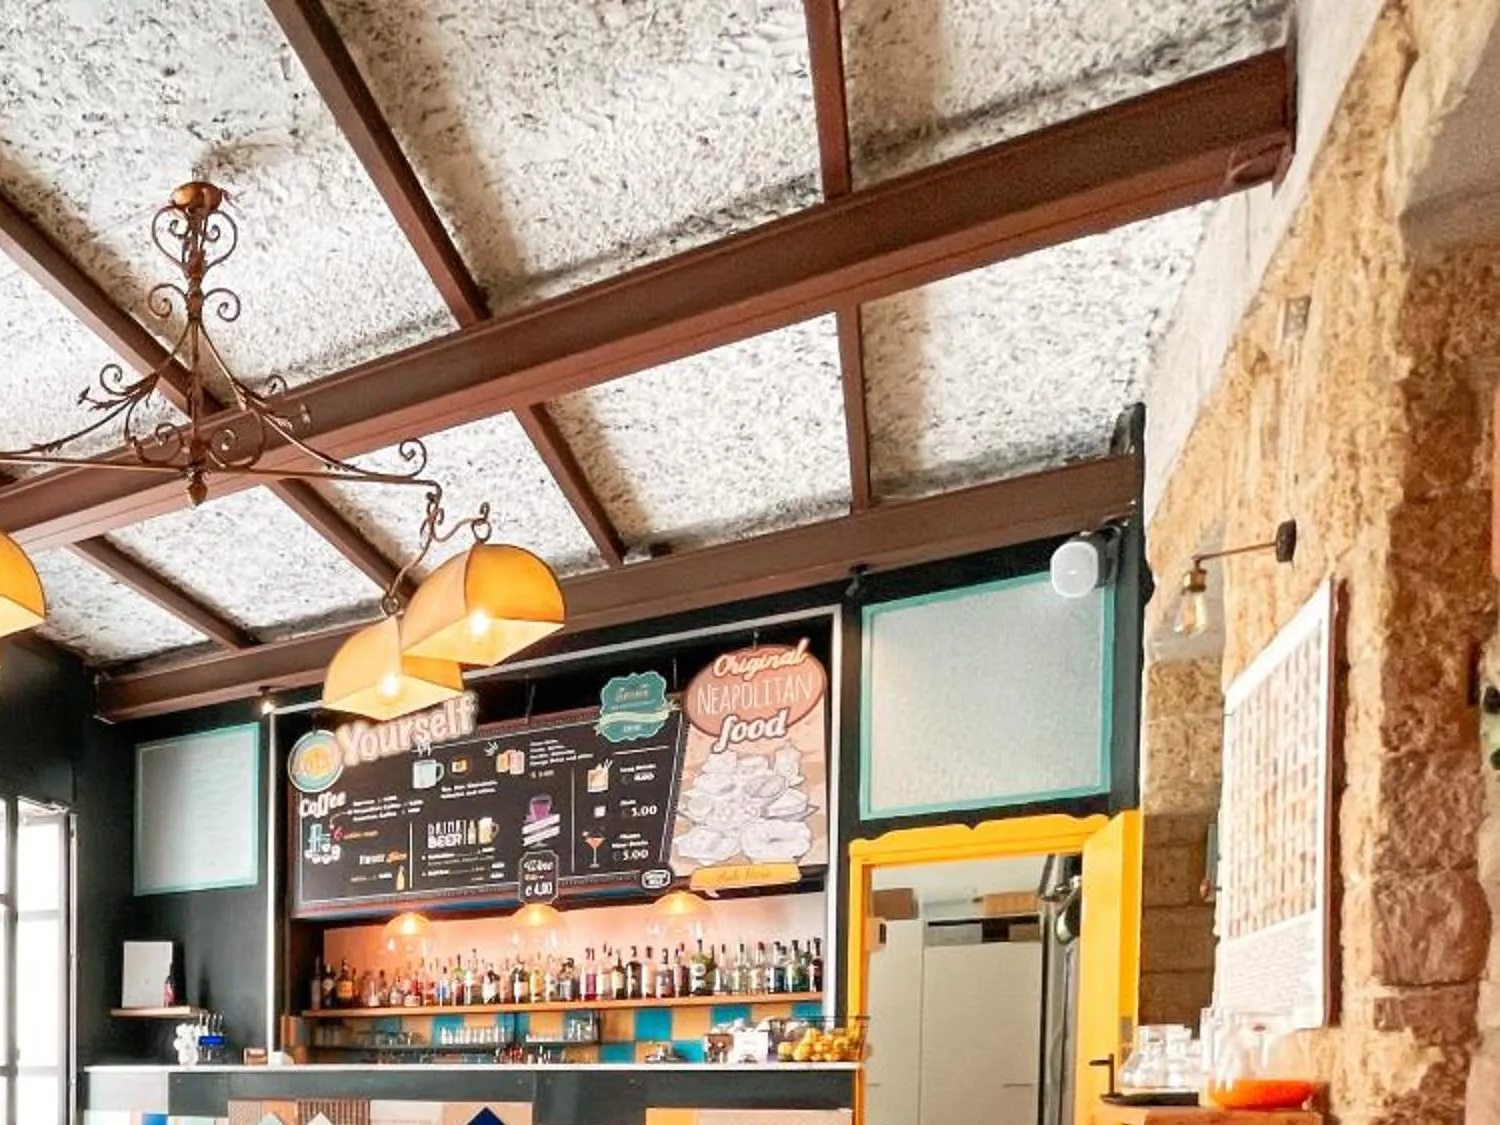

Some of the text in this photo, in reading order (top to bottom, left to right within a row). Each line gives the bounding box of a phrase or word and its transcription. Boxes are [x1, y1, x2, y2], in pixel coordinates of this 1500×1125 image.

[713, 637, 811, 678] Original
[697, 671, 814, 716] NEAPOLITAN
[338, 692, 478, 766] Yourself
[711, 706, 790, 754] food
[298, 790, 347, 819] Coffee
[427, 832, 462, 849] BEER
